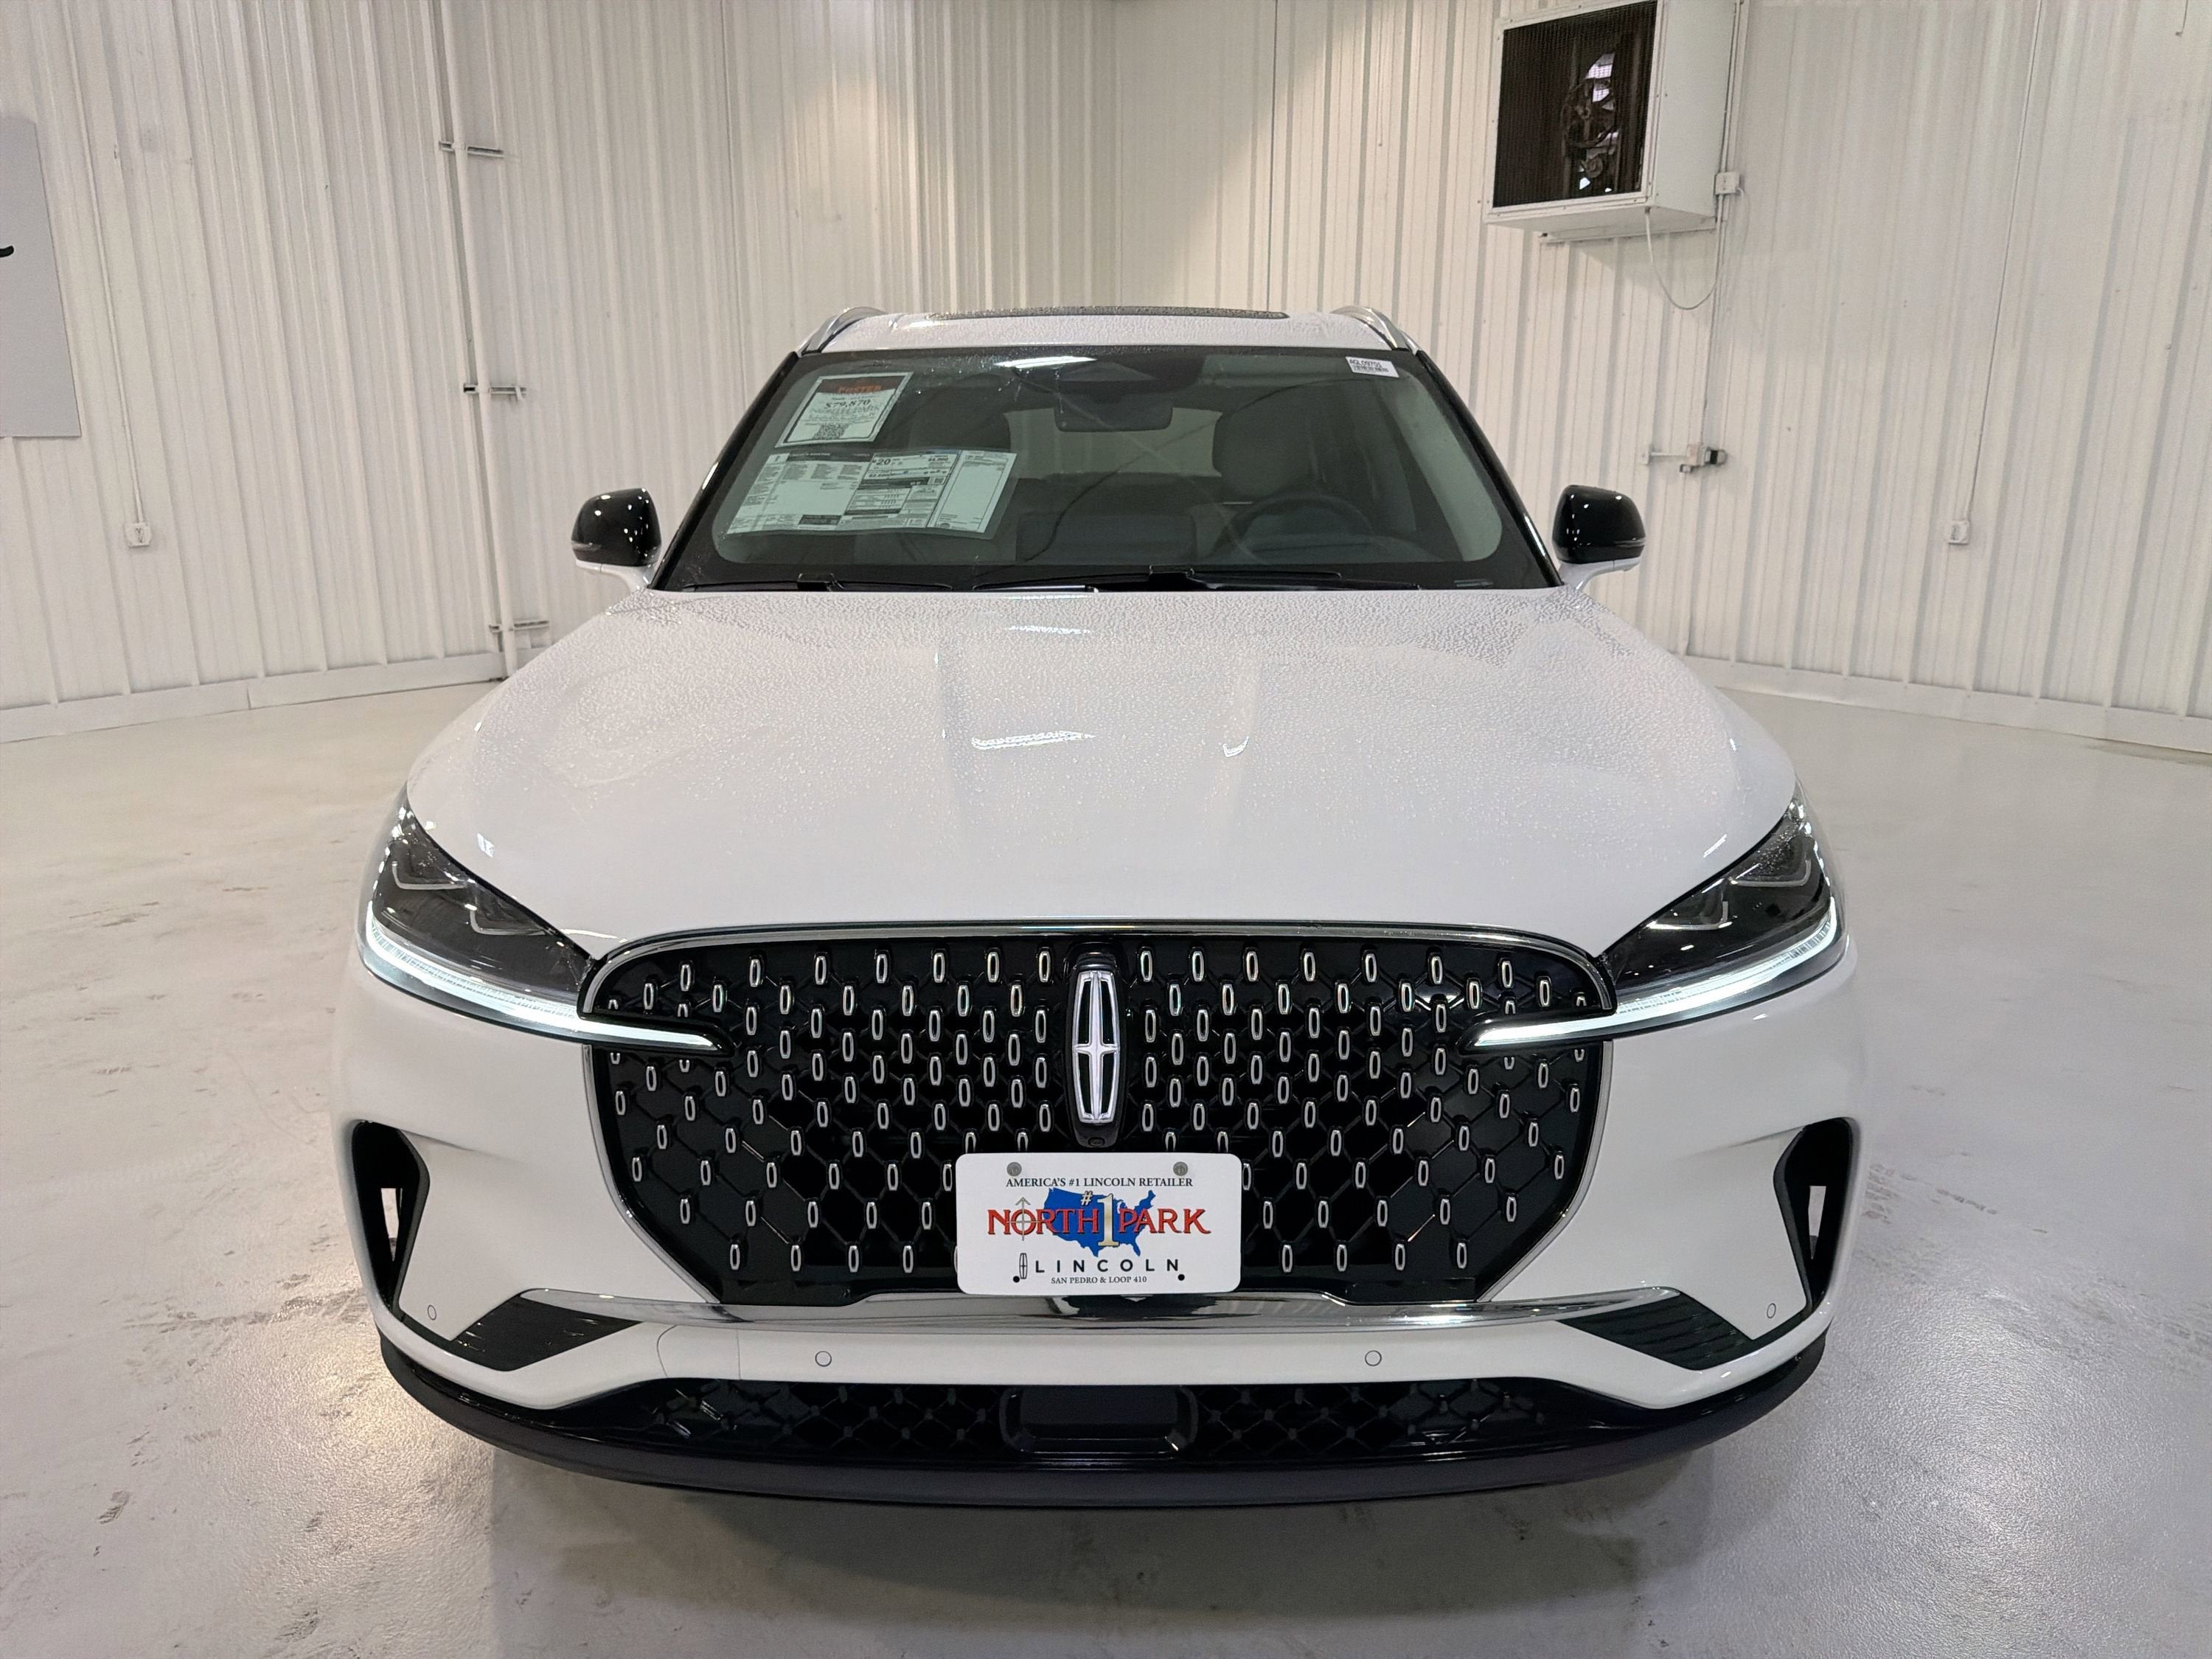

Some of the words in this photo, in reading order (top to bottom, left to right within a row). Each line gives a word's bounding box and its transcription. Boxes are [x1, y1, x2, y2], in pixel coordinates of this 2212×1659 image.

[1006, 1178, 1066, 1187] AMERICA'S
[1068, 1178, 1080, 1186] #1
[1084, 1178, 1135, 1187] LINCOLN
[1139, 1178, 1193, 1187] RETAILER
[987, 1208, 1099, 1235] NORTH
[1119, 1208, 1211, 1234] PARK
[1034, 1259, 1179, 1273] LINCOLN
[1051, 1276, 1068, 1284] SAN
[1069, 1276, 1098, 1284] PEDRO
[1133, 1276, 1148, 1284] 410
